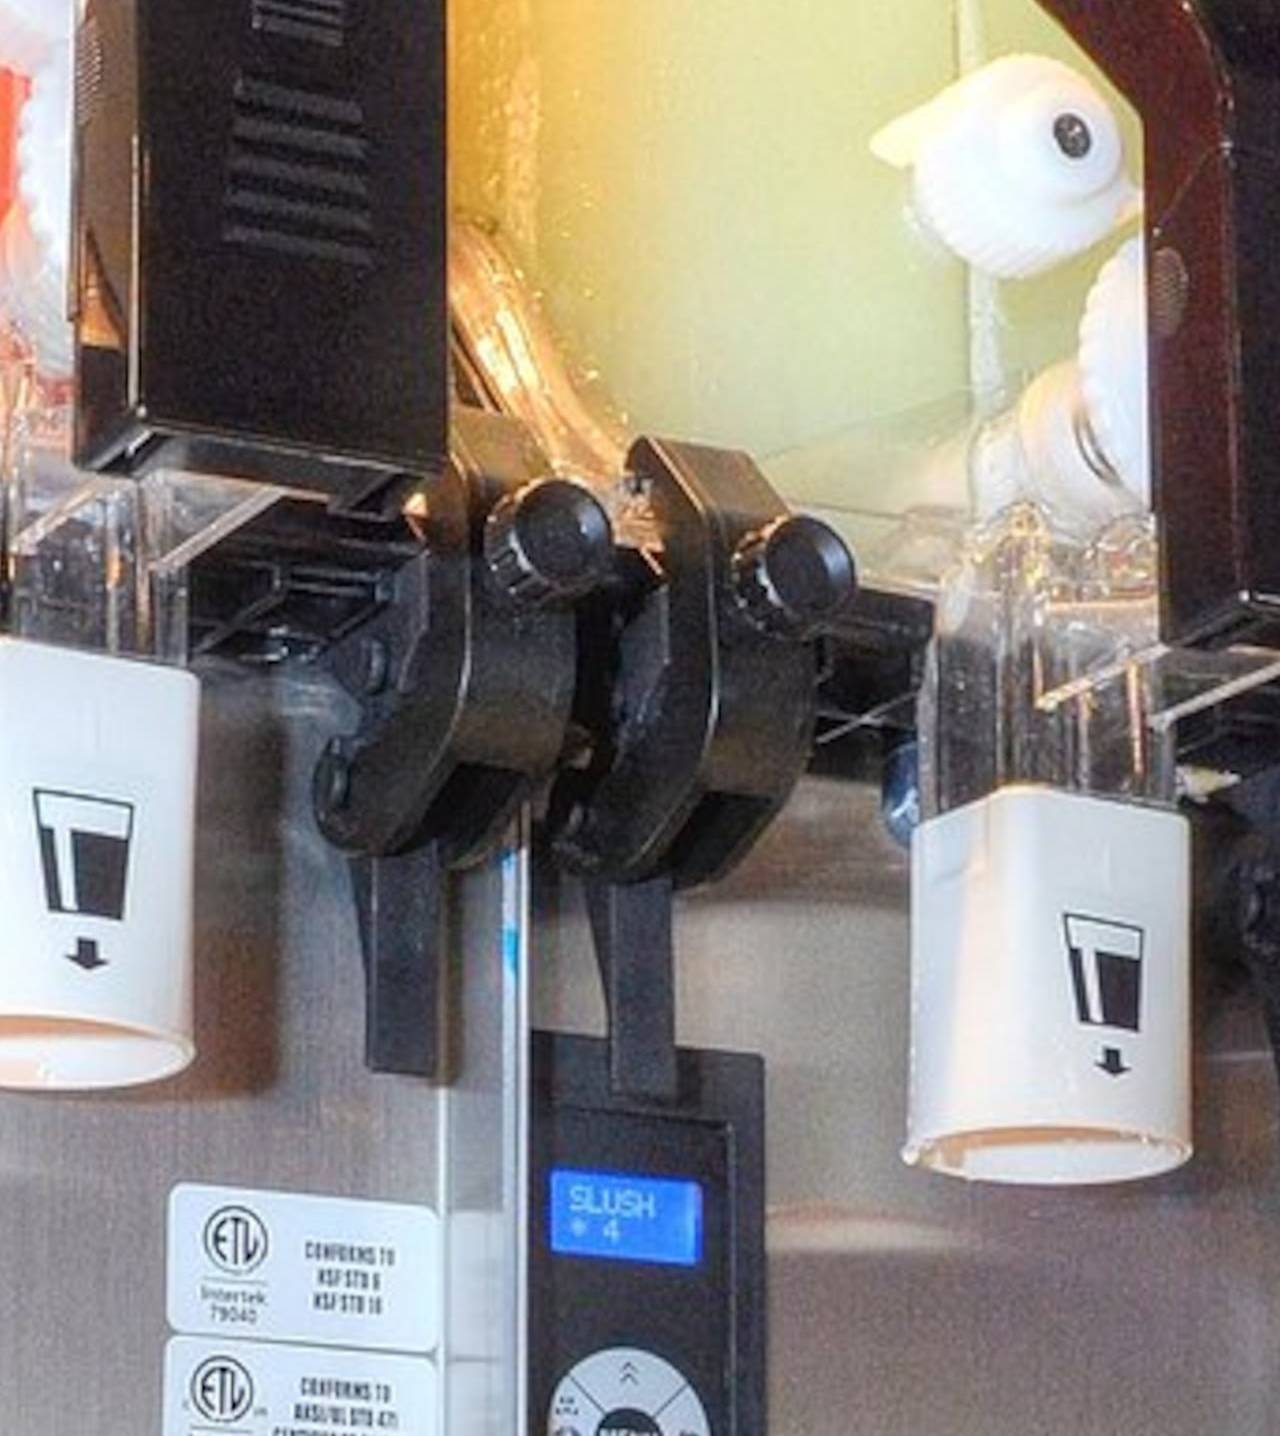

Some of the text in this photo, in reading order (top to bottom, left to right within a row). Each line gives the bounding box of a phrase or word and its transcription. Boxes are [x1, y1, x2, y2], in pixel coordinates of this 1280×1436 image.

[569, 1184, 655, 1220] SLUSH
[304, 1241, 396, 1267] CONFORMS TO
[301, 1376, 391, 1403] CONFORMS TO
